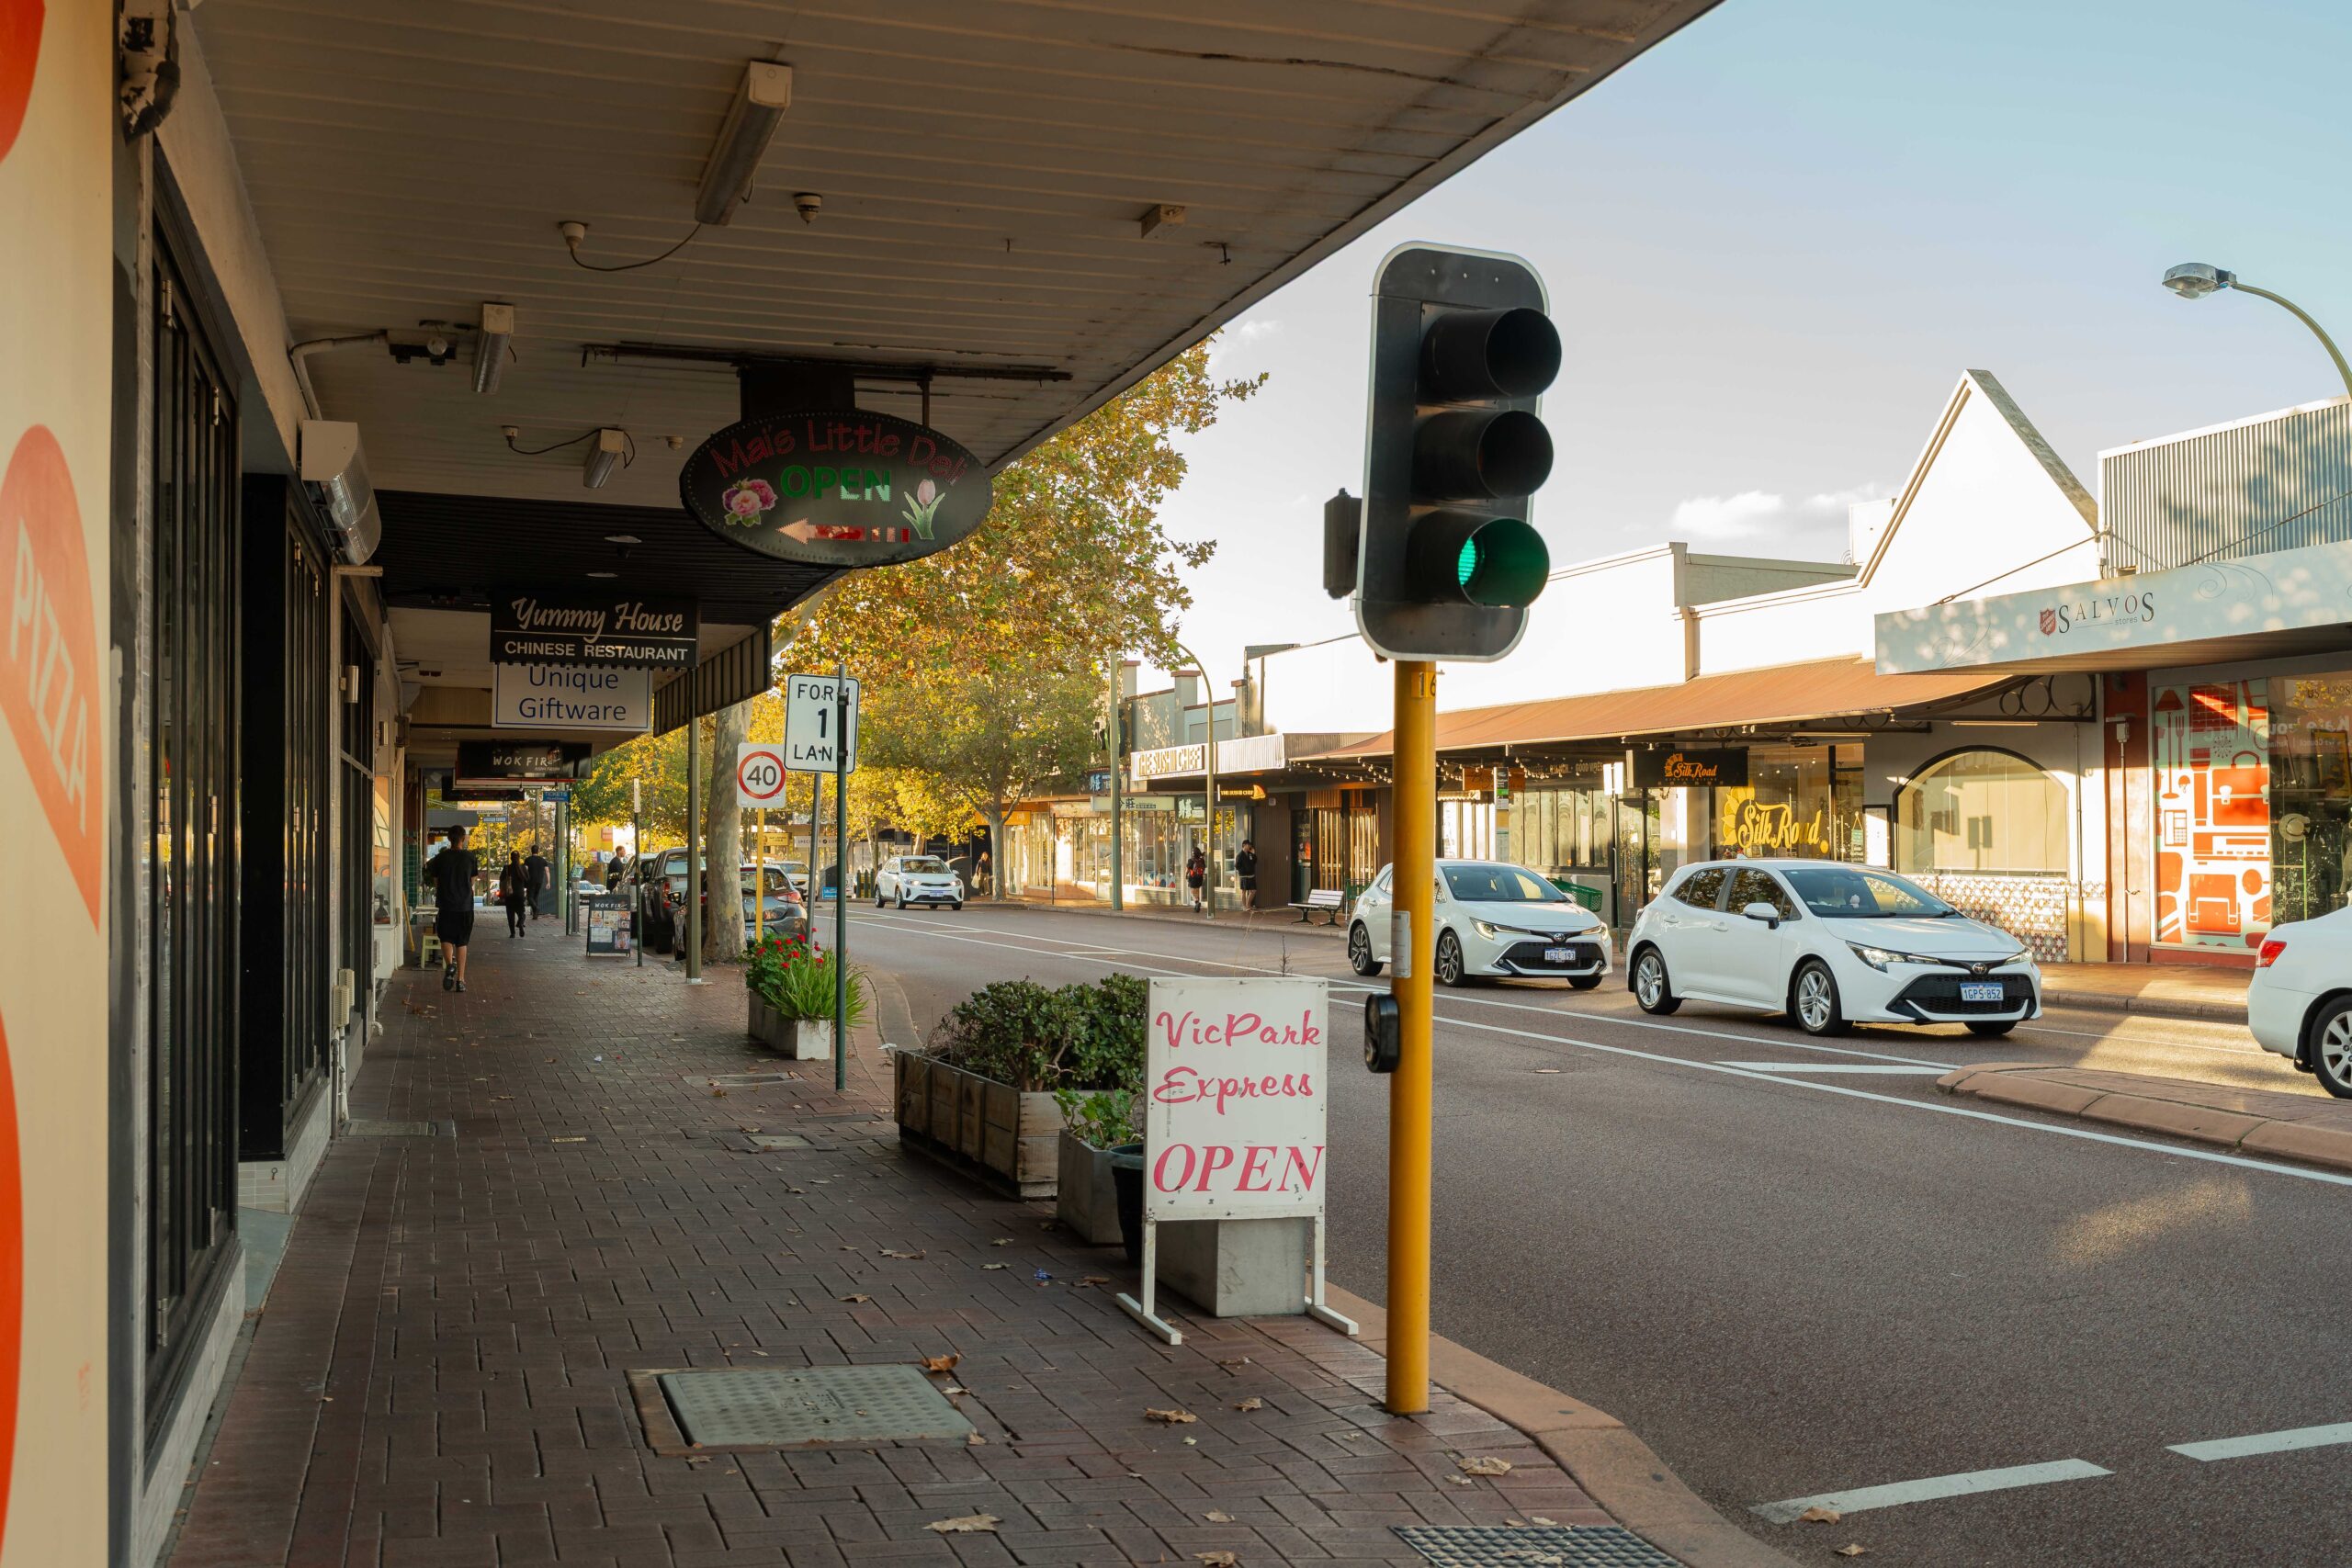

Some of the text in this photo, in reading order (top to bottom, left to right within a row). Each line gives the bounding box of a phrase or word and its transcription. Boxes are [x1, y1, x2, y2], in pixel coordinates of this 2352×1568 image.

[808, 420, 900, 457] Little
[906, 434, 969, 486] Deli
[780, 465, 891, 502] OPEN
[512, 597, 683, 644] Yummy House
[2058, 592, 2154, 634] SALVOS
[2115, 616, 2138, 625] stores
[504, 641, 688, 661] CHINESE RESTAURANT
[10, 515, 87, 838] PIZZA
[529, 666, 618, 693] Unique
[797, 683, 850, 701] FOR
[519, 697, 627, 721] Giftware
[818, 708, 828, 738] 1
[492, 756, 522, 766] WOK
[794, 744, 833, 761] LAN
[747, 765, 777, 786] 40
[1673, 762, 1718, 778] Silk Road
[1737, 805, 1771, 850] Silk
[1155, 1010, 1322, 1047] VicPark
[1153, 1066, 1314, 1114] Express
[1153, 1144, 1325, 1193] OPEN
